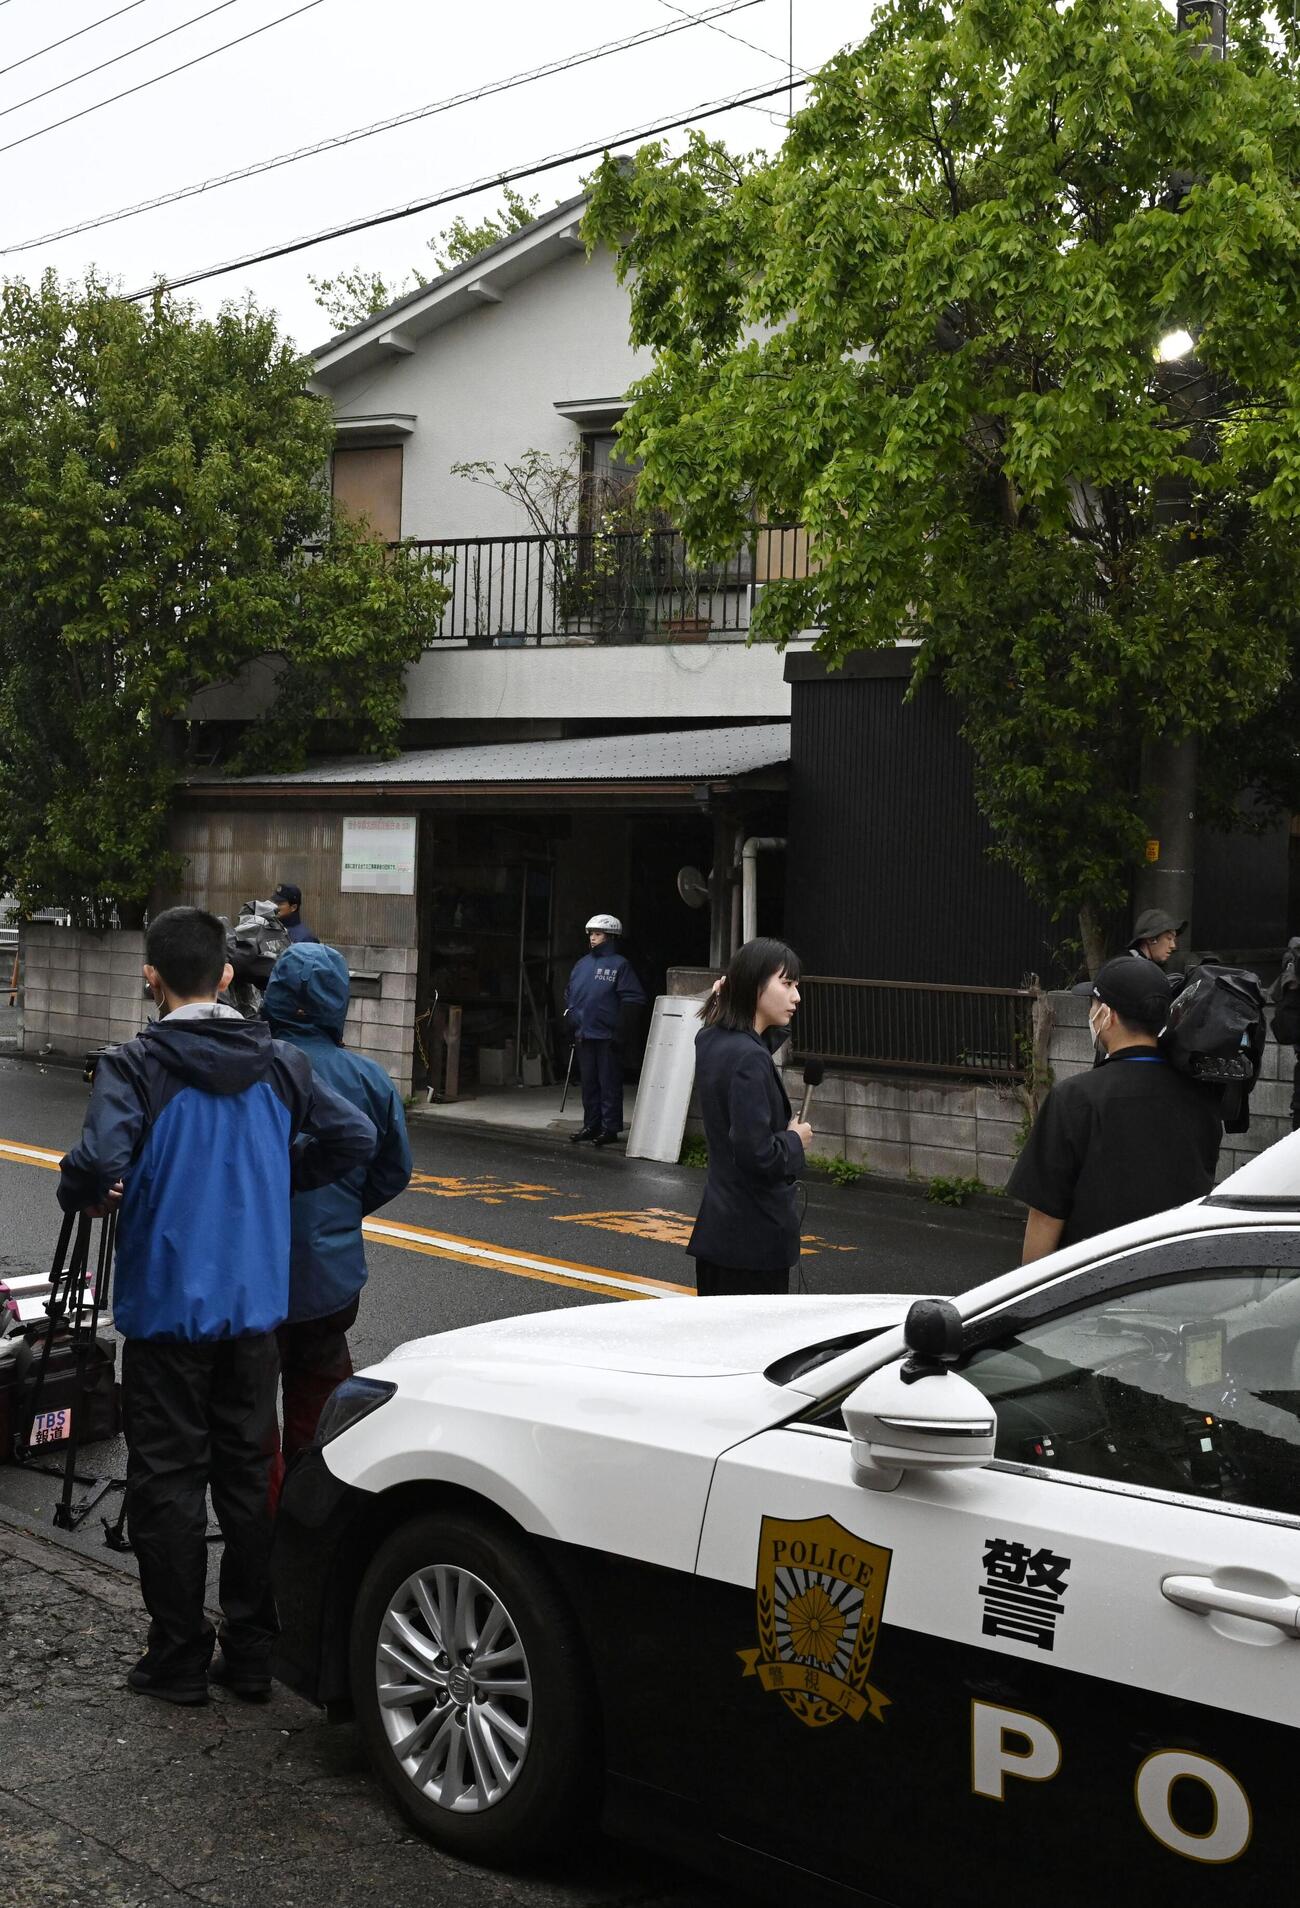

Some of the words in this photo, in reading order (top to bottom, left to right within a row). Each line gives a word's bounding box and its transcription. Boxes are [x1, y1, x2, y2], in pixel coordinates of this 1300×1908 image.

[595, 974, 616, 983] POLICE
[36, 1411, 65, 1429] TBS
[36, 1426, 63, 1444] 報道
[772, 1539, 874, 1588] POLICE
[978, 1538, 1072, 1652] 警
[768, 1665, 856, 1710] 警視庁
